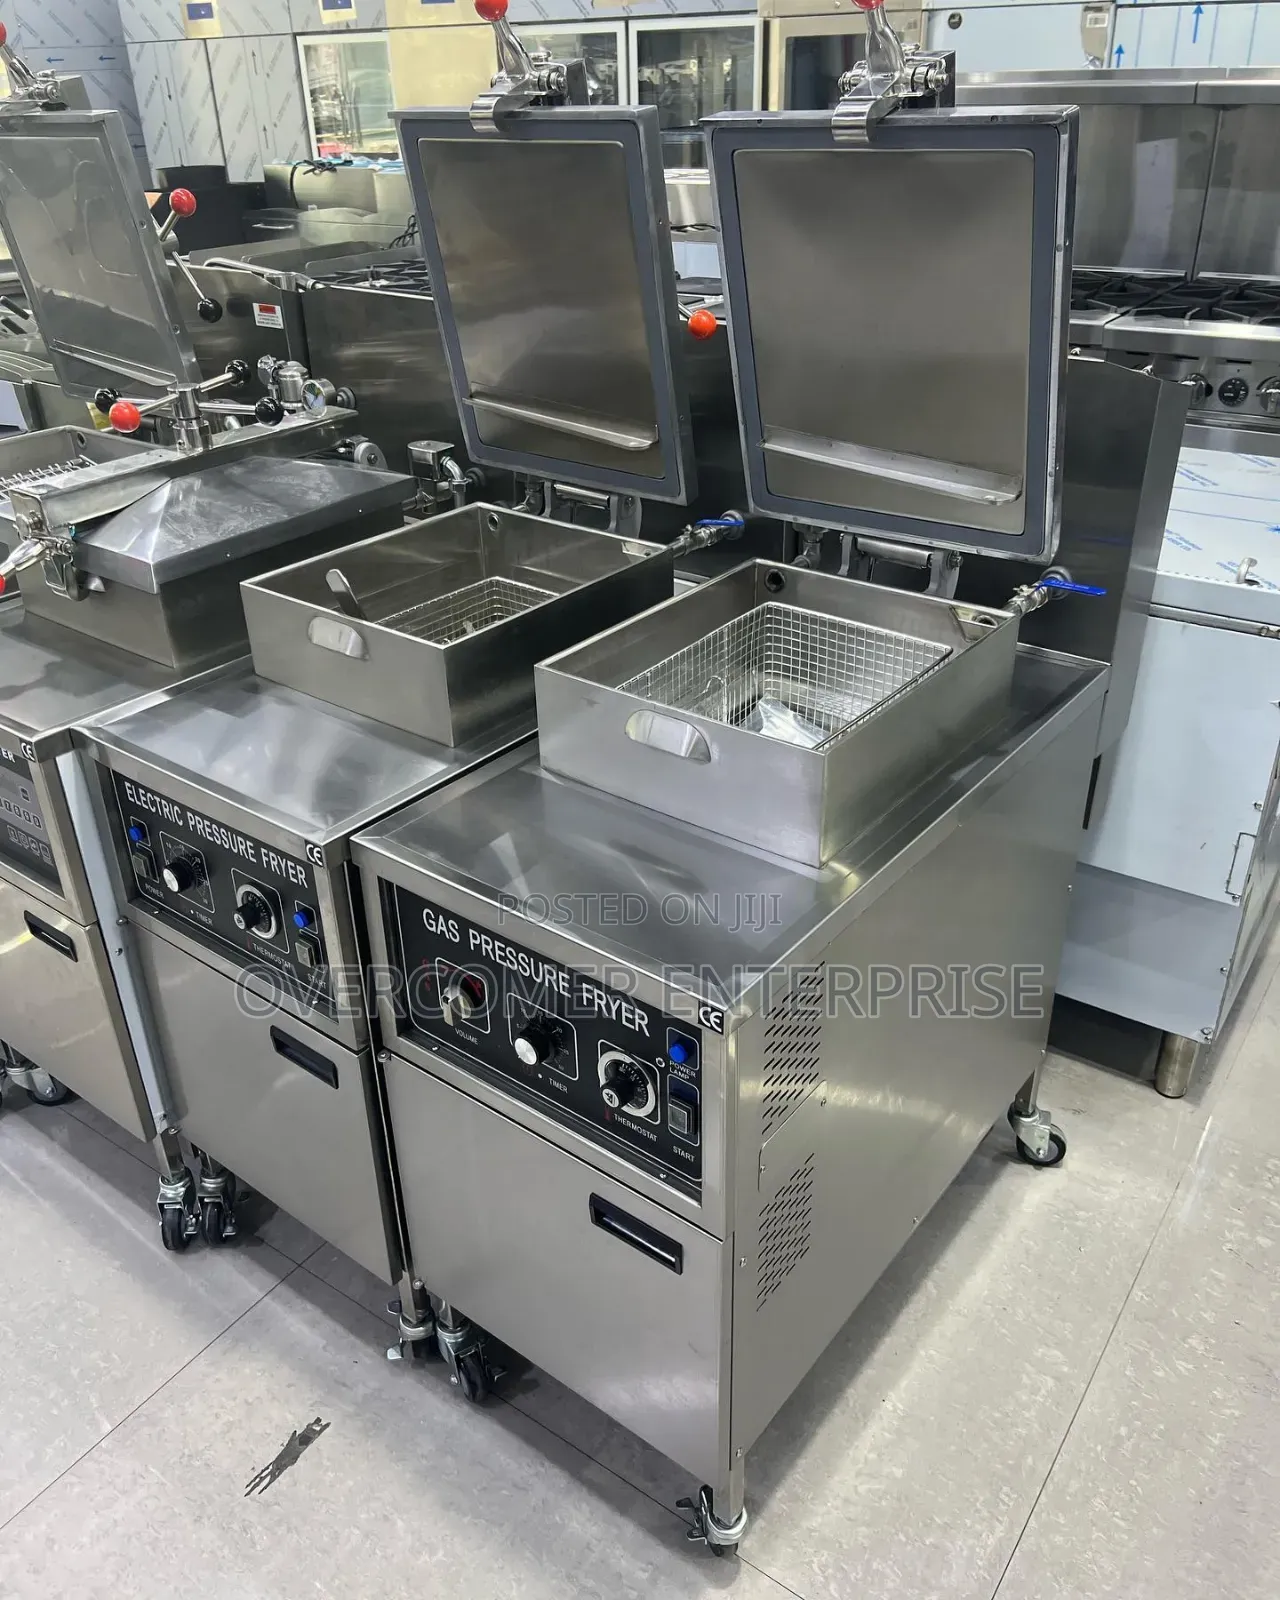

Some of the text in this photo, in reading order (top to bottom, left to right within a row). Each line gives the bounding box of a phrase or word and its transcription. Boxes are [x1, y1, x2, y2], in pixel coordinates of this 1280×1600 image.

[0, 749, 15, 763] ER
[21, 742, 35, 761] CE
[124, 781, 308, 888] ELECTRIC PRESSURE FRYER
[306, 843, 323, 866] CE
[195, 911, 213, 926] TIMER
[253, 943, 292, 969] THERMOSTAT
[307, 973, 327, 989] START
[422, 908, 460, 943] GAS
[469, 928, 572, 998] PRESSURE
[582, 983, 650, 1037] FRYER
[699, 1006, 723, 1033] CE
[455, 1028, 479, 1045] VOLUME
[669, 1060, 697, 1079] POWER
[669, 1067, 690, 1081] LAMP
[548, 1077, 568, 1094] TIMER
[613, 1113, 658, 1143] THERMOSTAT
[672, 1145, 696, 1163] START
